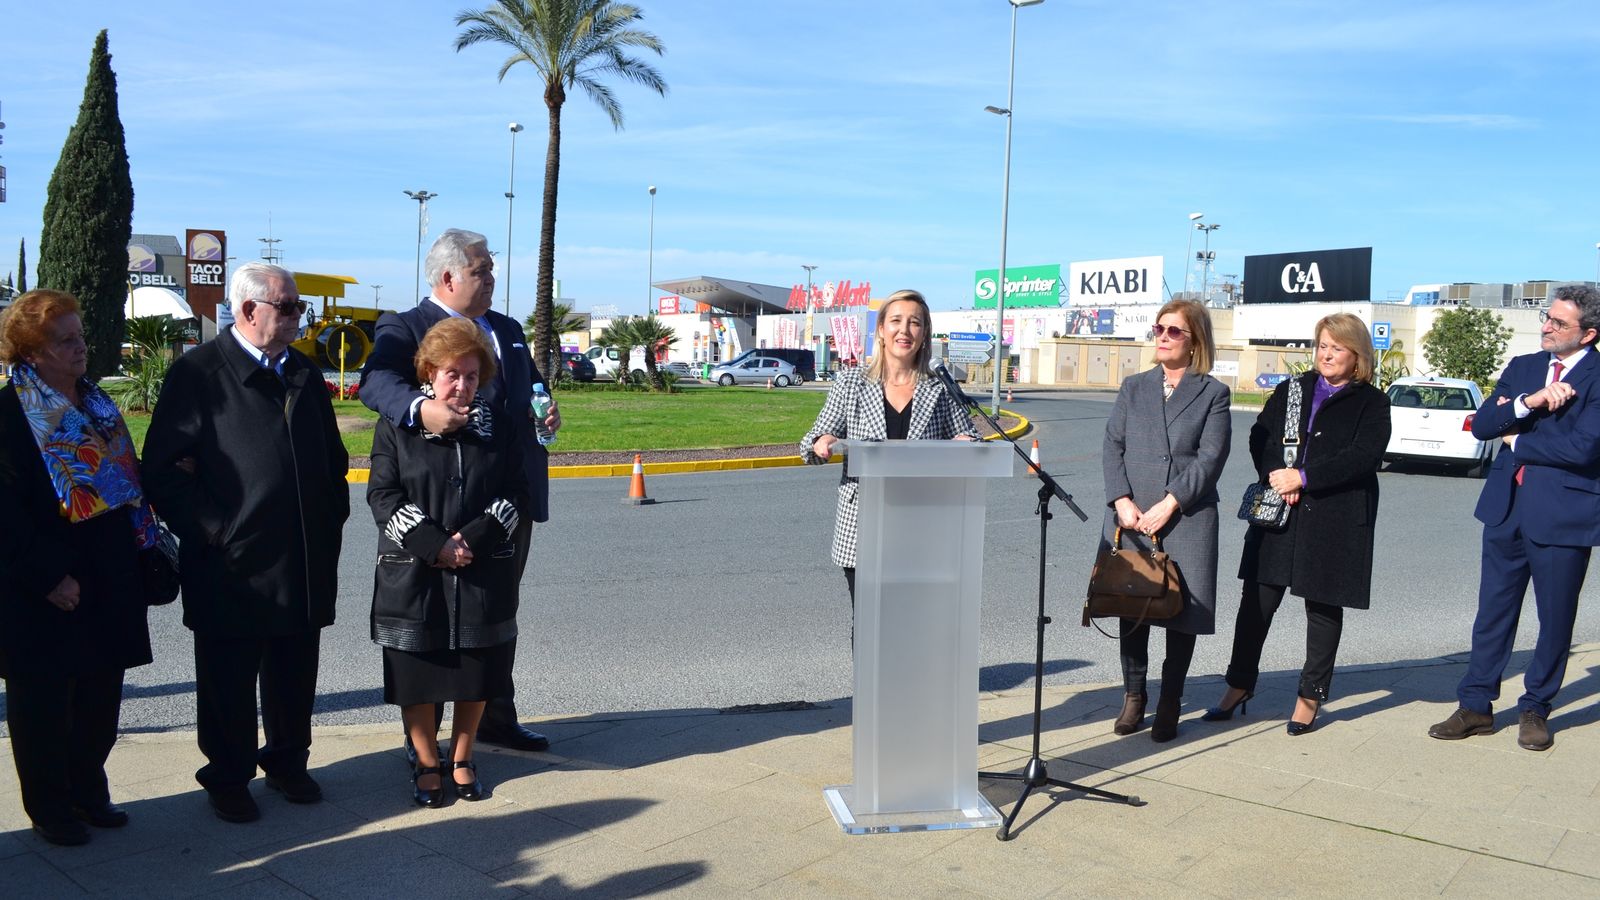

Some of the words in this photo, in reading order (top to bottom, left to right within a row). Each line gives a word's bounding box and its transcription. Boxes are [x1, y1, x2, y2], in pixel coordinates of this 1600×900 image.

[188, 263, 223, 274] TACO
[128, 273, 140, 285] O
[142, 274, 177, 286] BELL
[190, 274, 222, 285] BELL
[1080, 268, 1147, 295] KIABI
[1280, 262, 1325, 294] C&A
[1125, 314, 1148, 324] KIABI
